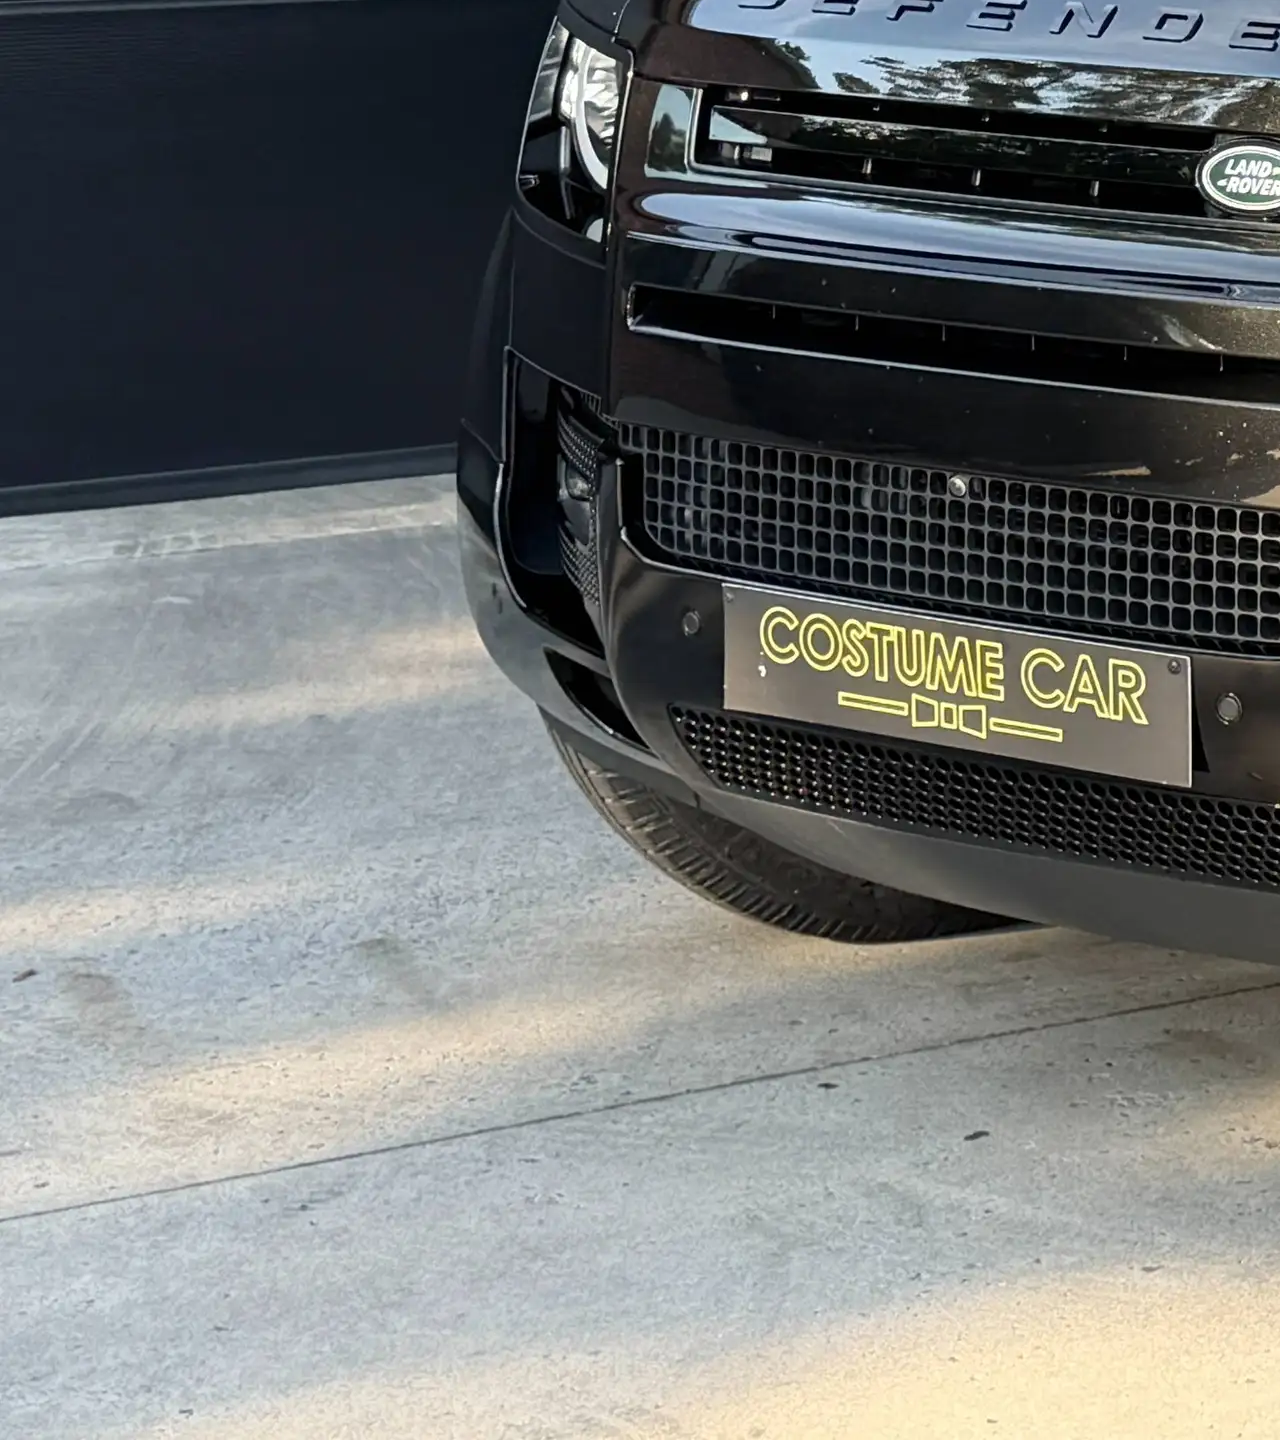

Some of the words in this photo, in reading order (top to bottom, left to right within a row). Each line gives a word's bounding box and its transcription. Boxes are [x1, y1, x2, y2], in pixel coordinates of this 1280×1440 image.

[1225, 159, 1273, 177] LAND
[760, 605, 1005, 702] COSTUME
[1019, 647, 1148, 726] CAR
